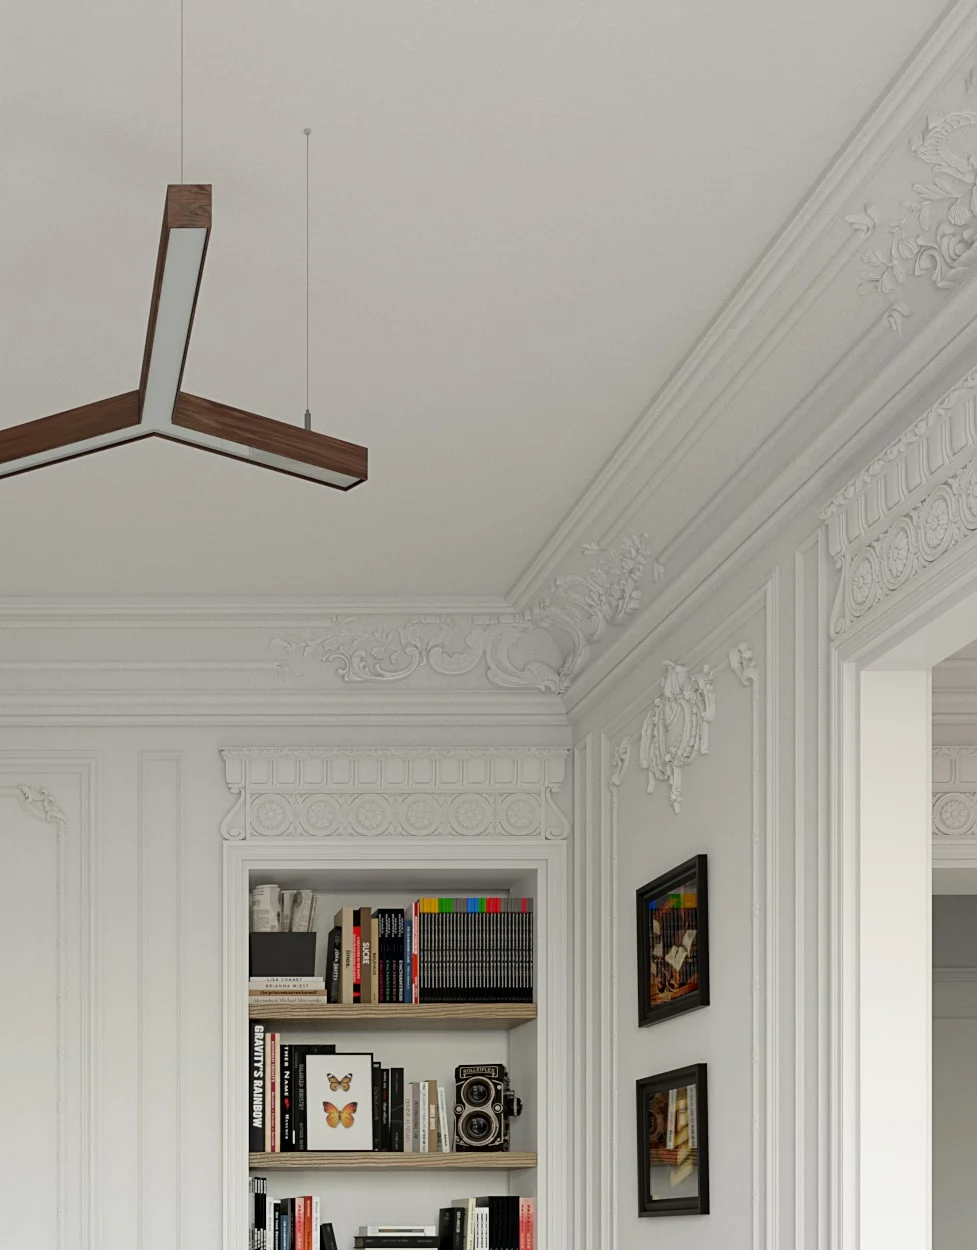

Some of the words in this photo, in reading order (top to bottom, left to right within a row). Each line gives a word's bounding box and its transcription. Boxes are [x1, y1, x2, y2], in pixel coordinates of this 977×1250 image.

[362, 942, 370, 965] SUCRE
[253, 1025, 264, 1078] GRAVITY'S
[252, 1080, 263, 1128] RAINBOW
